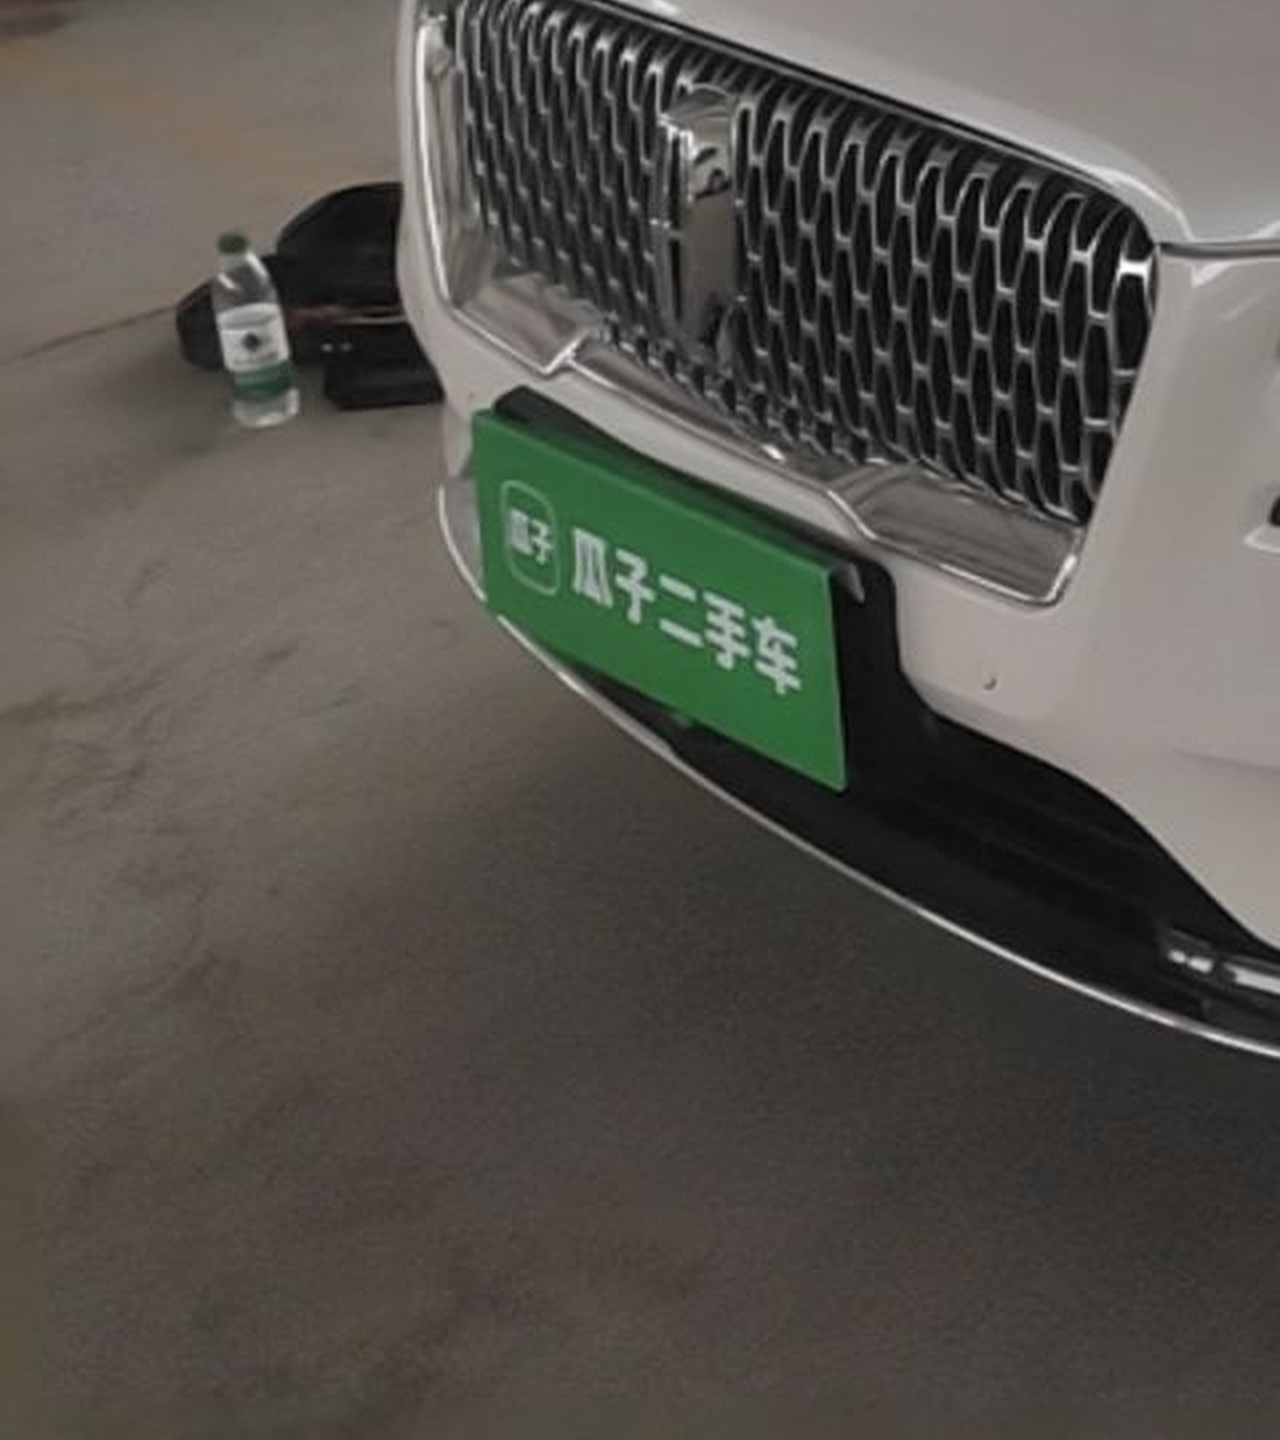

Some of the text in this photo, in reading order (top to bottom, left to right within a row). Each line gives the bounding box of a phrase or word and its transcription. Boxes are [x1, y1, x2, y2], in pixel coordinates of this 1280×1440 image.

[572, 526, 801, 695] 瓜子二手车
